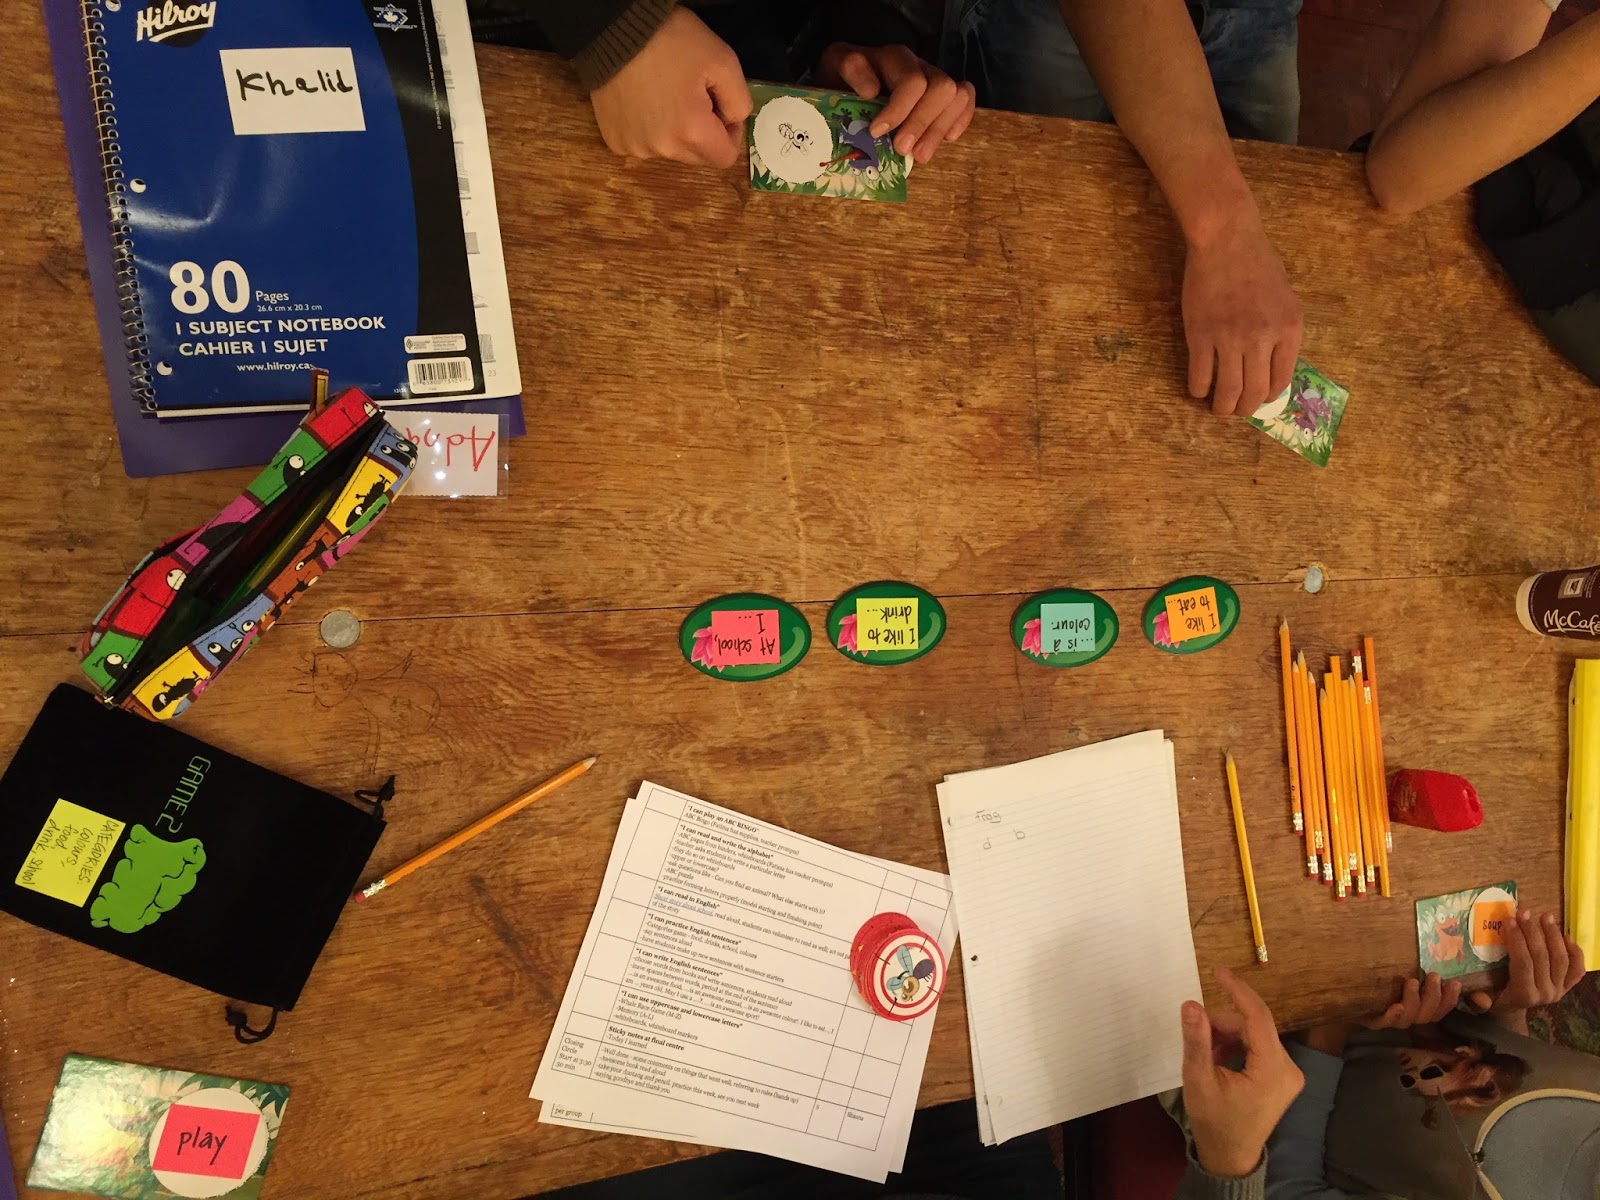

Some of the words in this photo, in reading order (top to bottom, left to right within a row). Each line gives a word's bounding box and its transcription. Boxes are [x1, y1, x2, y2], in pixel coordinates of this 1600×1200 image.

[135, 0, 217, 42] Hilroy
[236, 68, 353, 101] Khalid
[169, 260, 250, 315] 80
[255, 290, 290, 304] Pages
[257, 304, 273, 312] 26.6
[294, 303, 310, 311] 20.3
[311, 303, 323, 311] cm
[188, 319, 273, 337] SUBJECT
[278, 316, 386, 333] NOTEBOOK
[178, 340, 255, 357] CAHIER
[273, 338, 329, 356] SUJET
[236, 361, 310, 372] www.hilroy.ca
[1184, 616, 1206, 632] like
[883, 628, 904, 645] like
[164, 755, 212, 816] GAME
[662, 888, 674, 896] can
[674, 890, 689, 900] read
[653, 915, 665, 923] can
[664, 917, 689, 931] practice
[688, 925, 711, 938] English
[1482, 920, 1502, 937] soup
[641, 949, 653, 957] can
[652, 952, 669, 962] write
[668, 956, 692, 970] English
[626, 992, 638, 1000] can
[638, 995, 649, 1003] use
[648, 999, 680, 1013] uppercase
[679, 1006, 692, 1015] and
[691, 1009, 721, 1023] lowercase
[607, 1025, 627, 1037] Sticky
[626, 1030, 644, 1040] notes
[643, 1034, 651, 1042] at
[650, 1036, 665, 1046] final
[664, 1040, 685, 1051] centre
[177, 1126, 228, 1166] play
